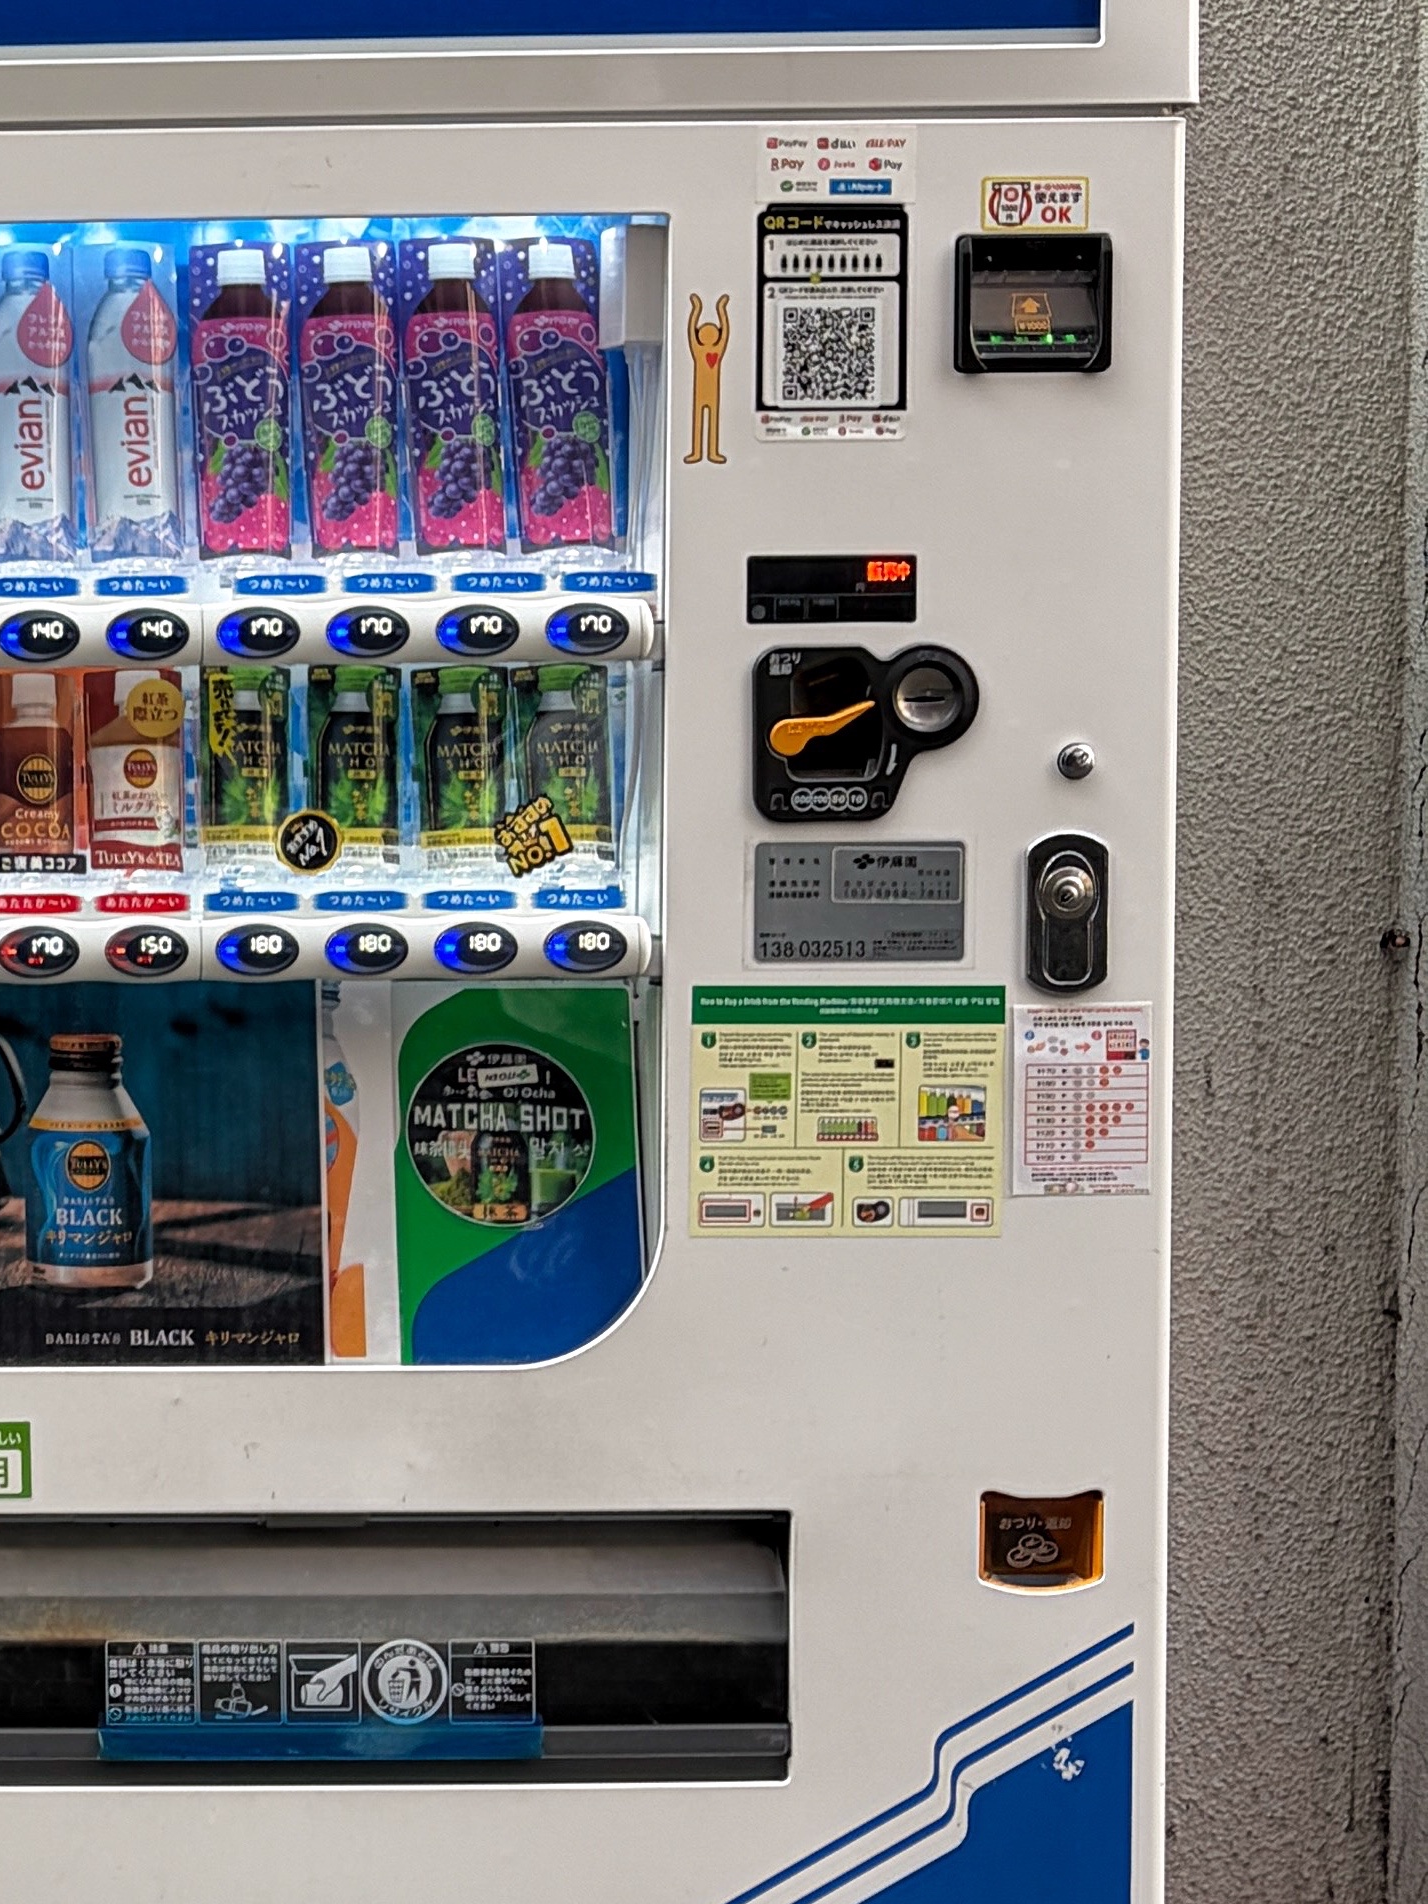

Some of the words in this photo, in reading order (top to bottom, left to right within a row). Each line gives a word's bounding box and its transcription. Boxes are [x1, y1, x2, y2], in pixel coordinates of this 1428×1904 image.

[1034, 192, 1083, 204] 使えます
[1040, 205, 1072, 224] OK
[205, 366, 285, 417] ぶどう
[313, 364, 393, 414] ぶどう
[419, 361, 496, 413] ぶどう
[521, 360, 600, 409] ぶどう
[15, 395, 45, 491] evian
[120, 394, 152, 488] evian
[32, 622, 64, 639] 140
[141, 621, 173, 638] 140
[769, 652, 802, 665] おつり
[142, 692, 169, 707] 紅茶
[132, 706, 179, 721] 際立つ
[328, 742, 390, 757] MATCHA
[437, 742, 499, 758] MATCHA
[14, 807, 60, 823] Creamy
[0, 822, 70, 839] COCOA
[250, 935, 283, 953] 180
[358, 934, 391, 953] 180
[468, 933, 501, 952] 180
[578, 932, 611, 951] 180
[759, 940, 794, 958] 138
[798, 940, 866, 958] 032513
[414, 1103, 509, 1132] MATCHA
[520, 1104, 585, 1132] SHOT
[54, 1206, 123, 1226] BLACK
[45, 1230, 134, 1246] キリマンジャロ
[129, 1328, 195, 1347] BLACK
[205, 1329, 301, 1345] キリマンジャロ
[999, 1515, 1072, 1531] おつり・返却
